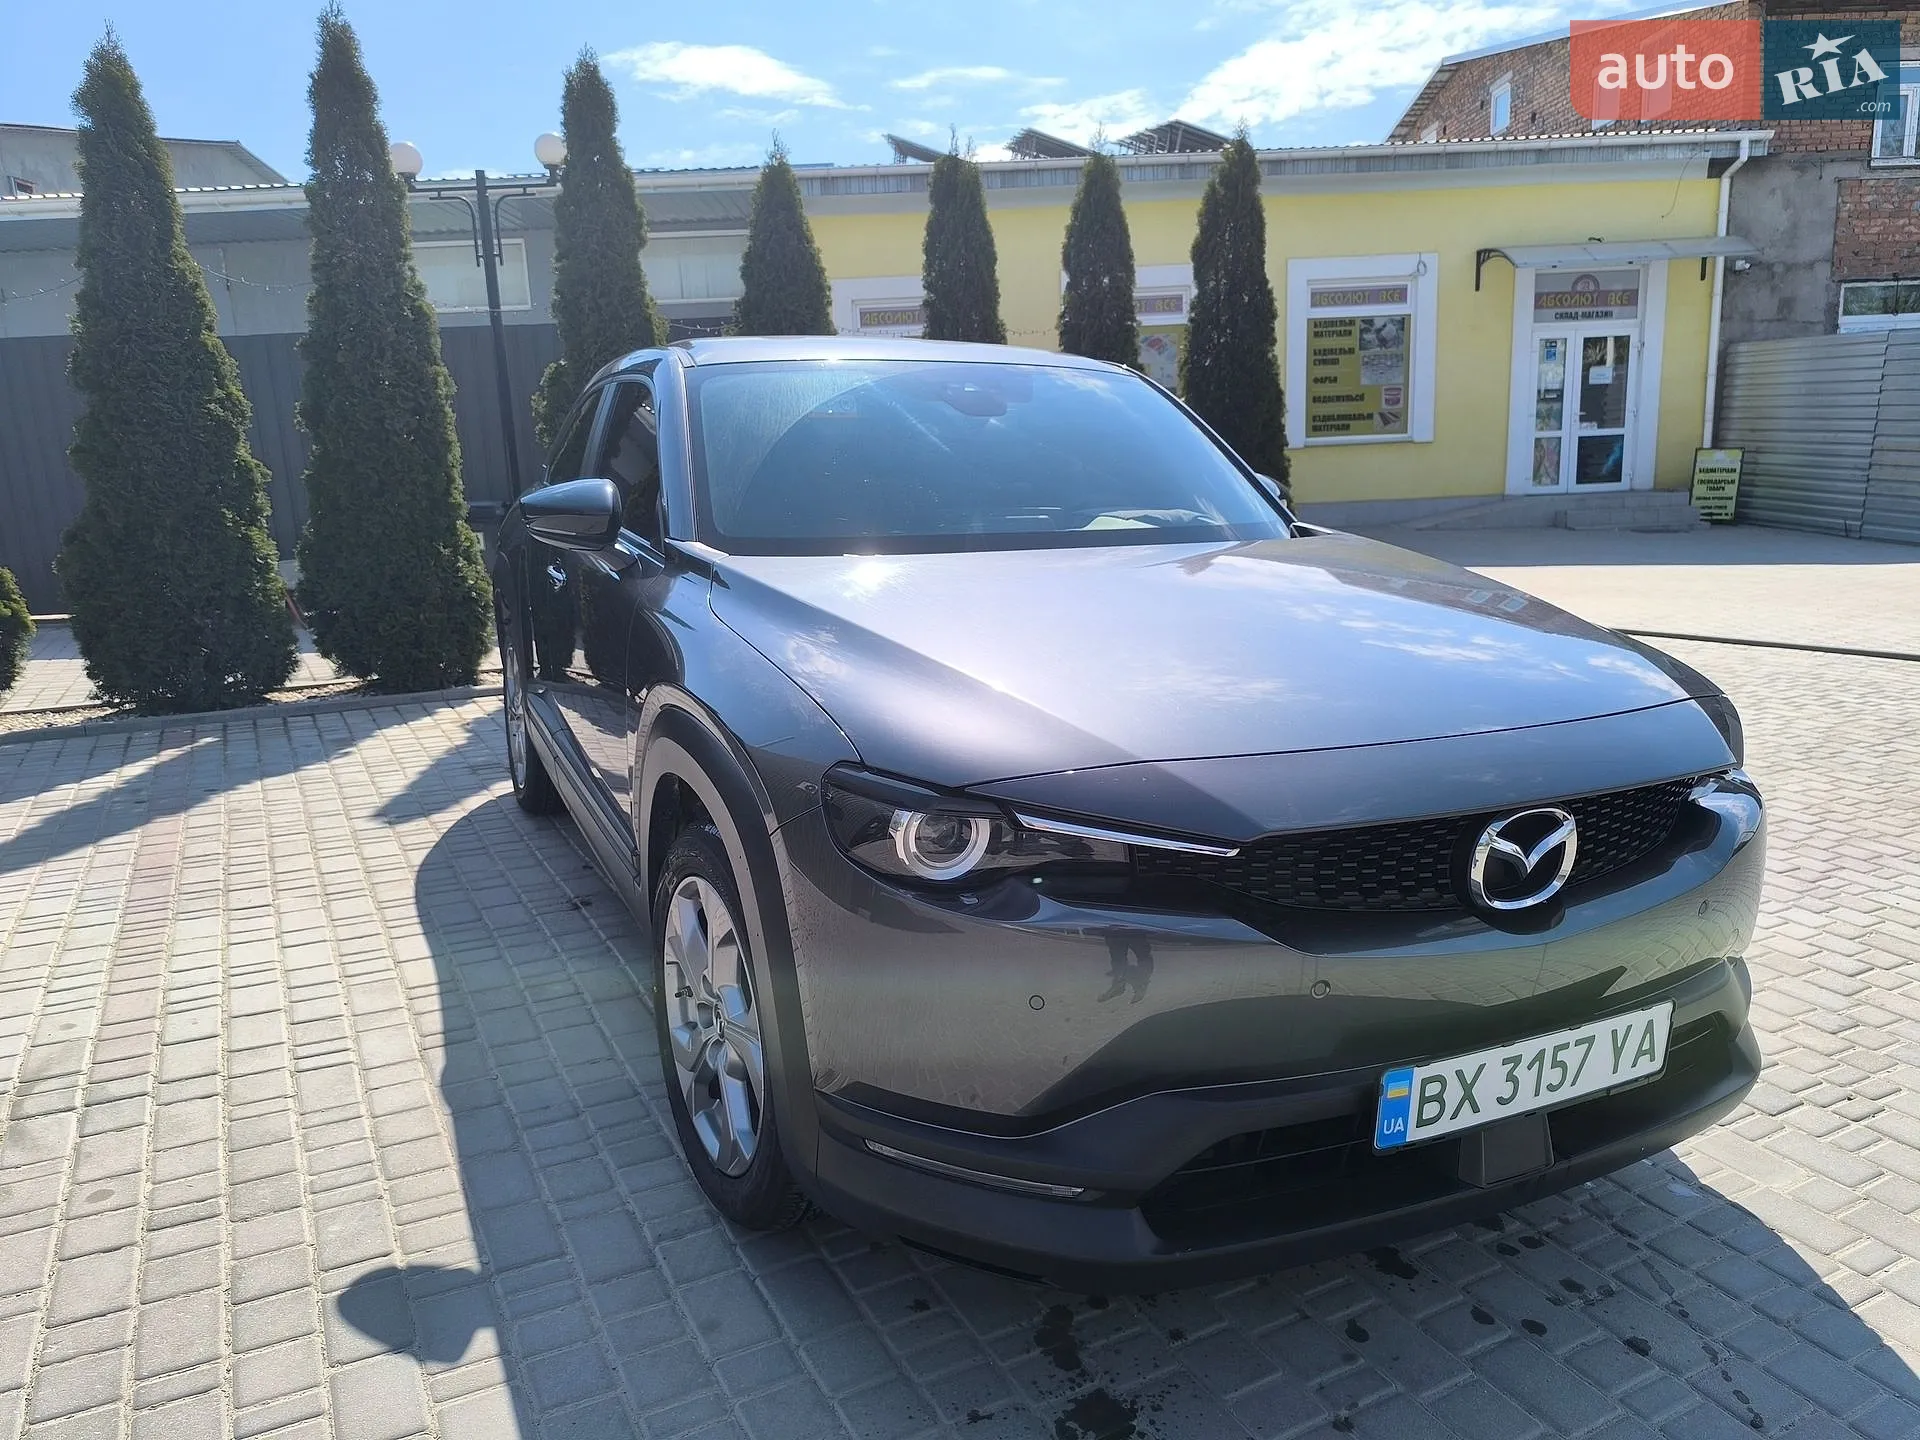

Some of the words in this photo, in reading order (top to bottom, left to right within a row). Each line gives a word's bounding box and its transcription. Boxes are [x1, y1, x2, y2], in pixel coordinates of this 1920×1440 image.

[1313, 290, 1370, 306] АБСОЛЮТ
[1379, 290, 1401, 302] ВСЕ
[1537, 292, 1599, 307] АБСОЛЮТ
[1608, 291, 1632, 305] ВСЕ
[1416, 1063, 1486, 1128] BX
[1496, 1034, 1596, 1106] 3157
[1611, 1019, 1655, 1074] YA
[1383, 1117, 1405, 1135] UA
